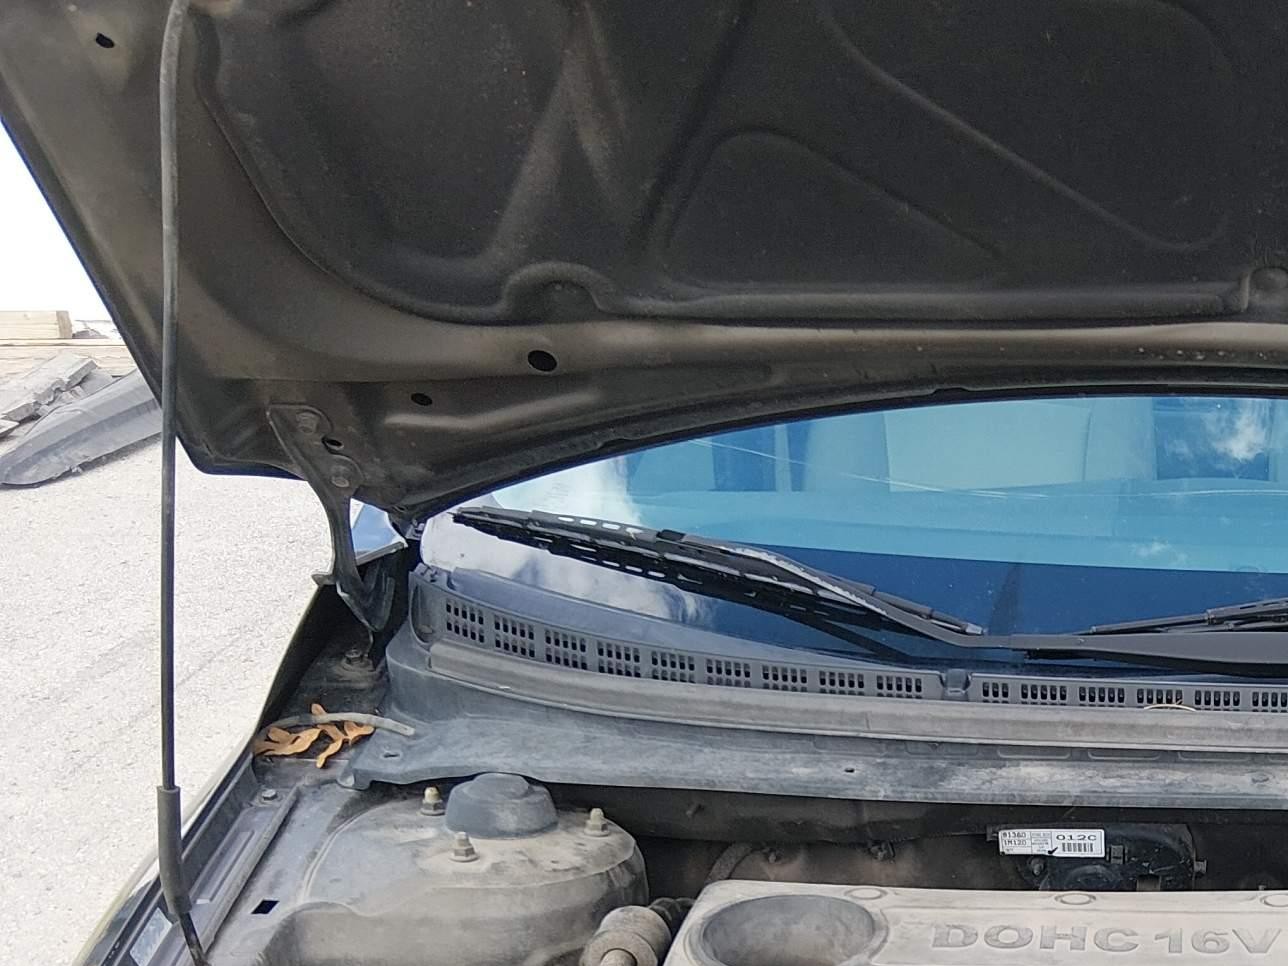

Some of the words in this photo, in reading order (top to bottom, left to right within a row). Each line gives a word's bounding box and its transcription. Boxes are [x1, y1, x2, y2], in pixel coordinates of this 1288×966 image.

[1055, 834, 1098, 842] 012C
[931, 924, 1140, 953] DOHC
[1155, 927, 1283, 954] 16V
